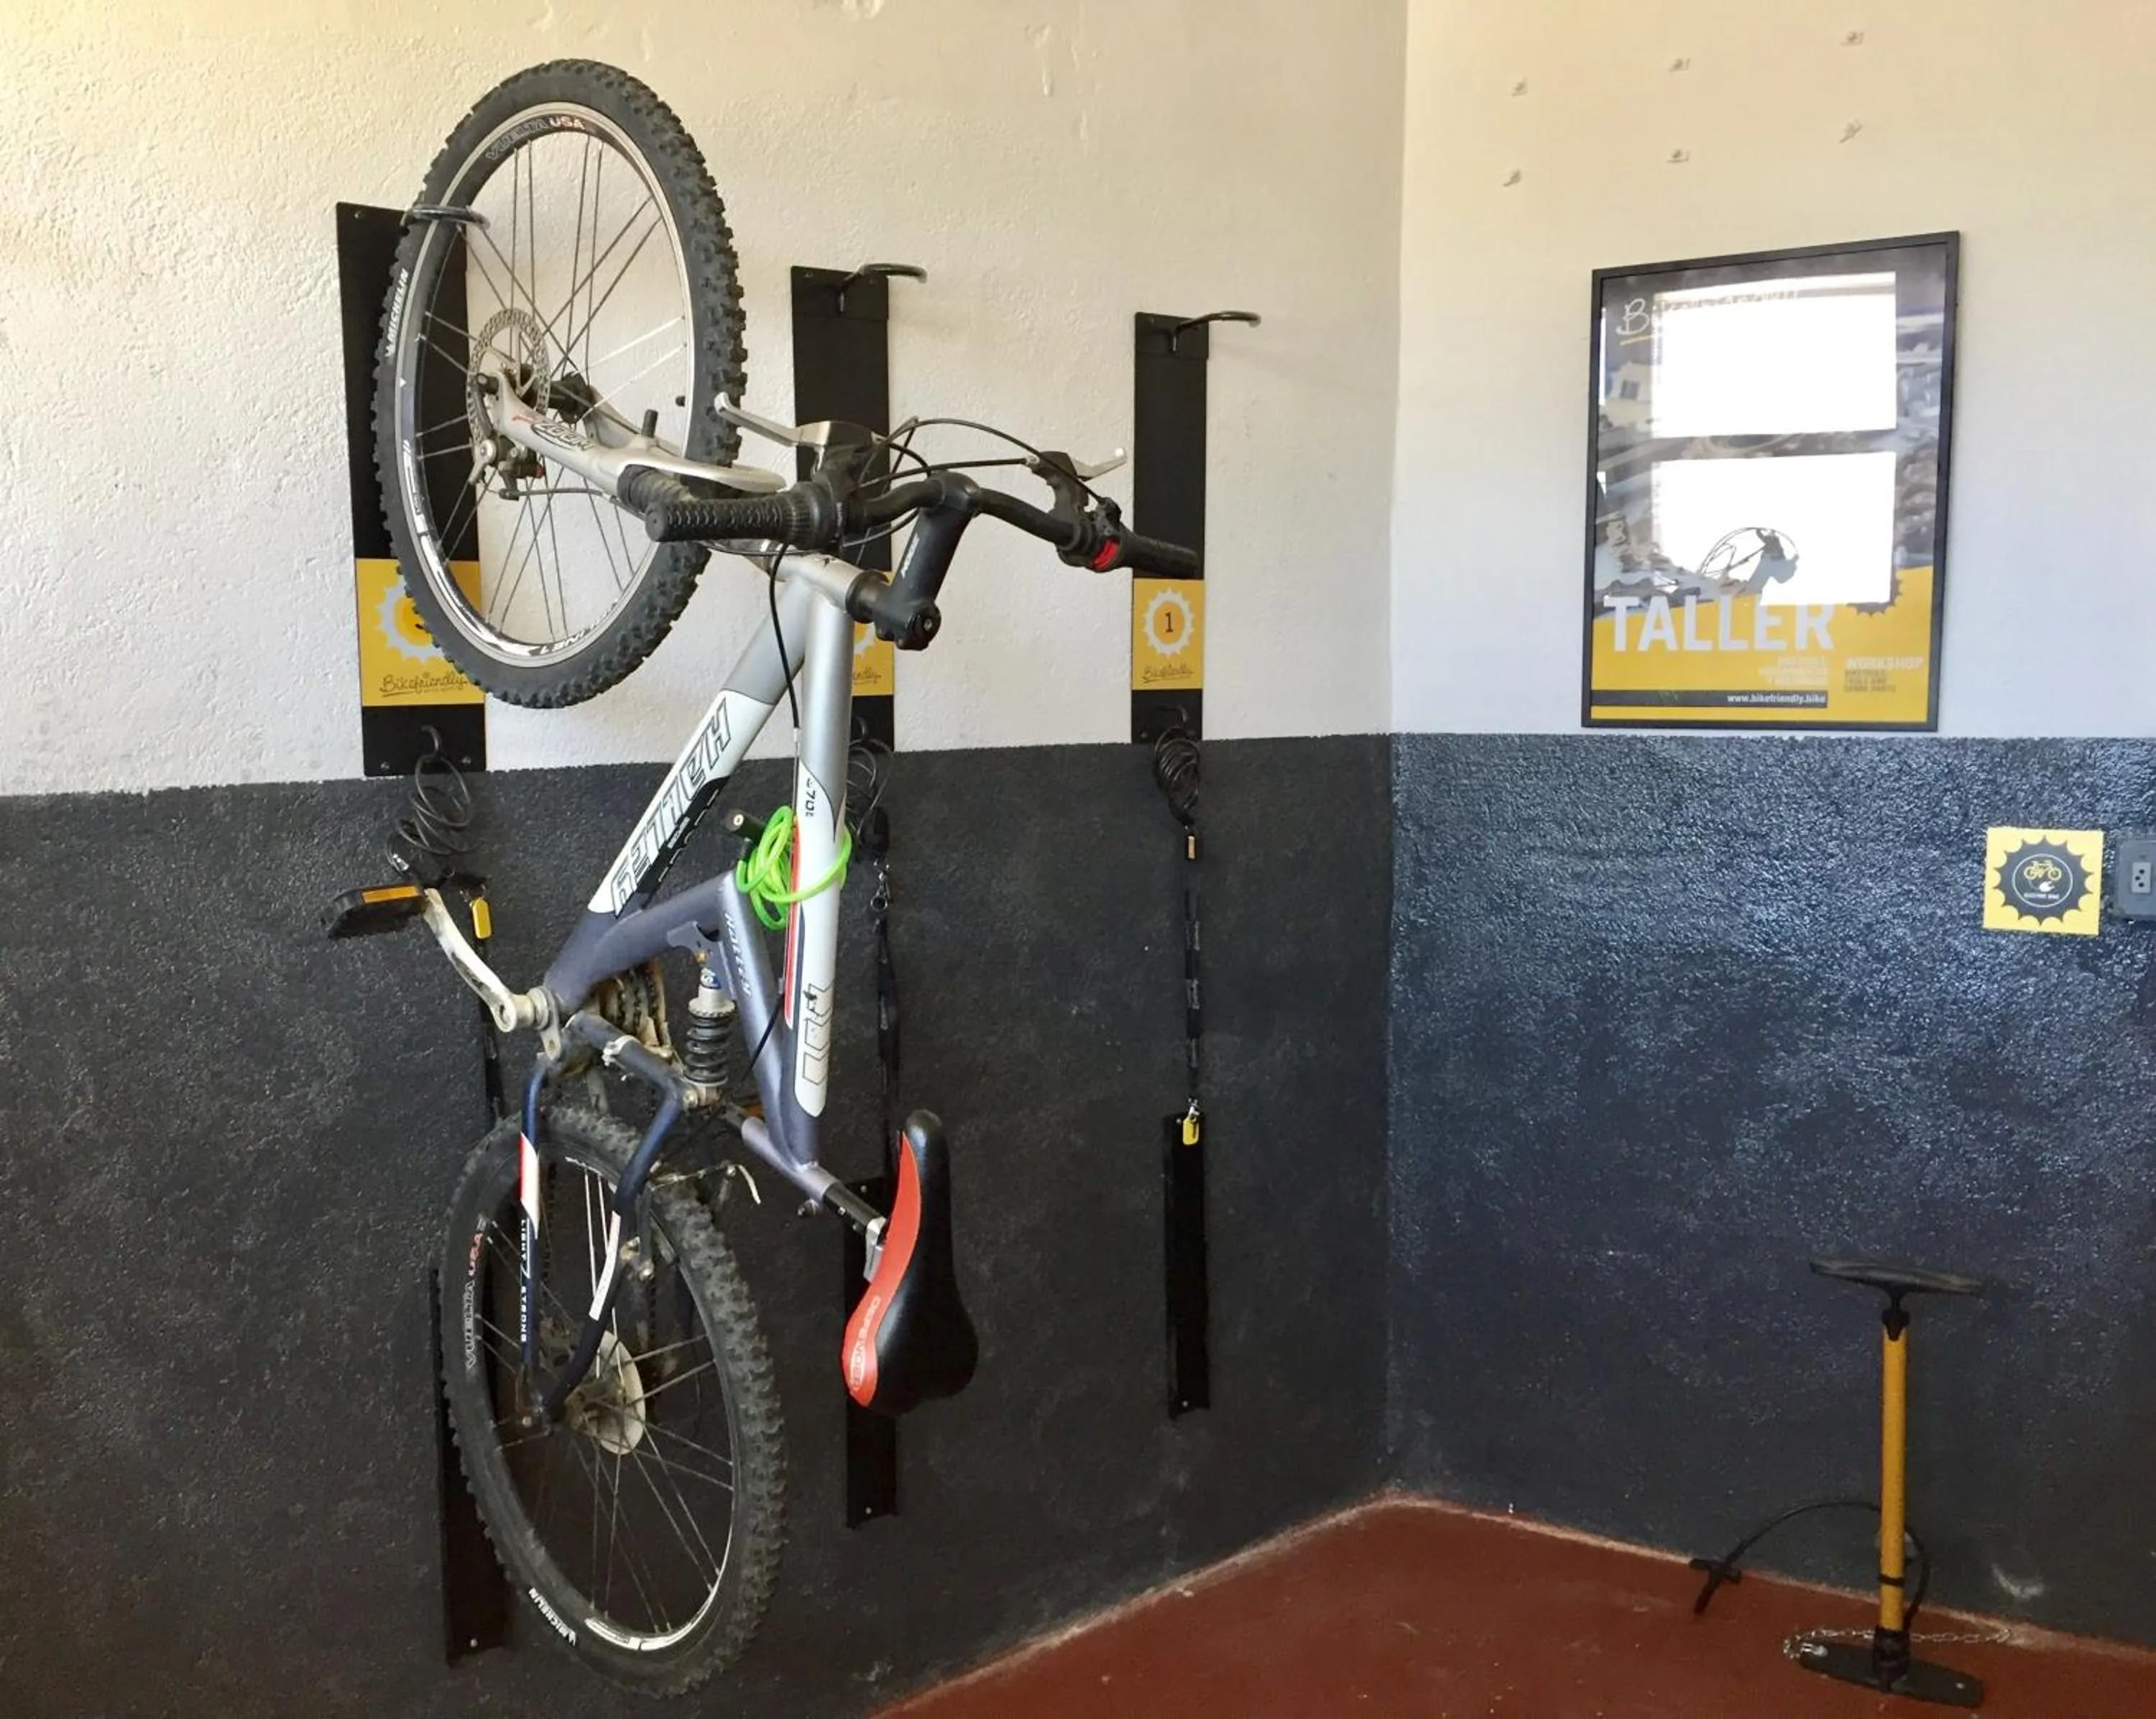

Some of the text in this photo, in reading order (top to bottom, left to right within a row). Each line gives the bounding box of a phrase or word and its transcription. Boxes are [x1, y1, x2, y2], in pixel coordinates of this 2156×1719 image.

[549, 115, 586, 130] USA
[388, 267, 409, 344] MICHELIN
[1164, 612, 1174, 633] 1
[1603, 595, 1835, 652] TALLER
[528, 1586, 572, 1639] MICHELIN
